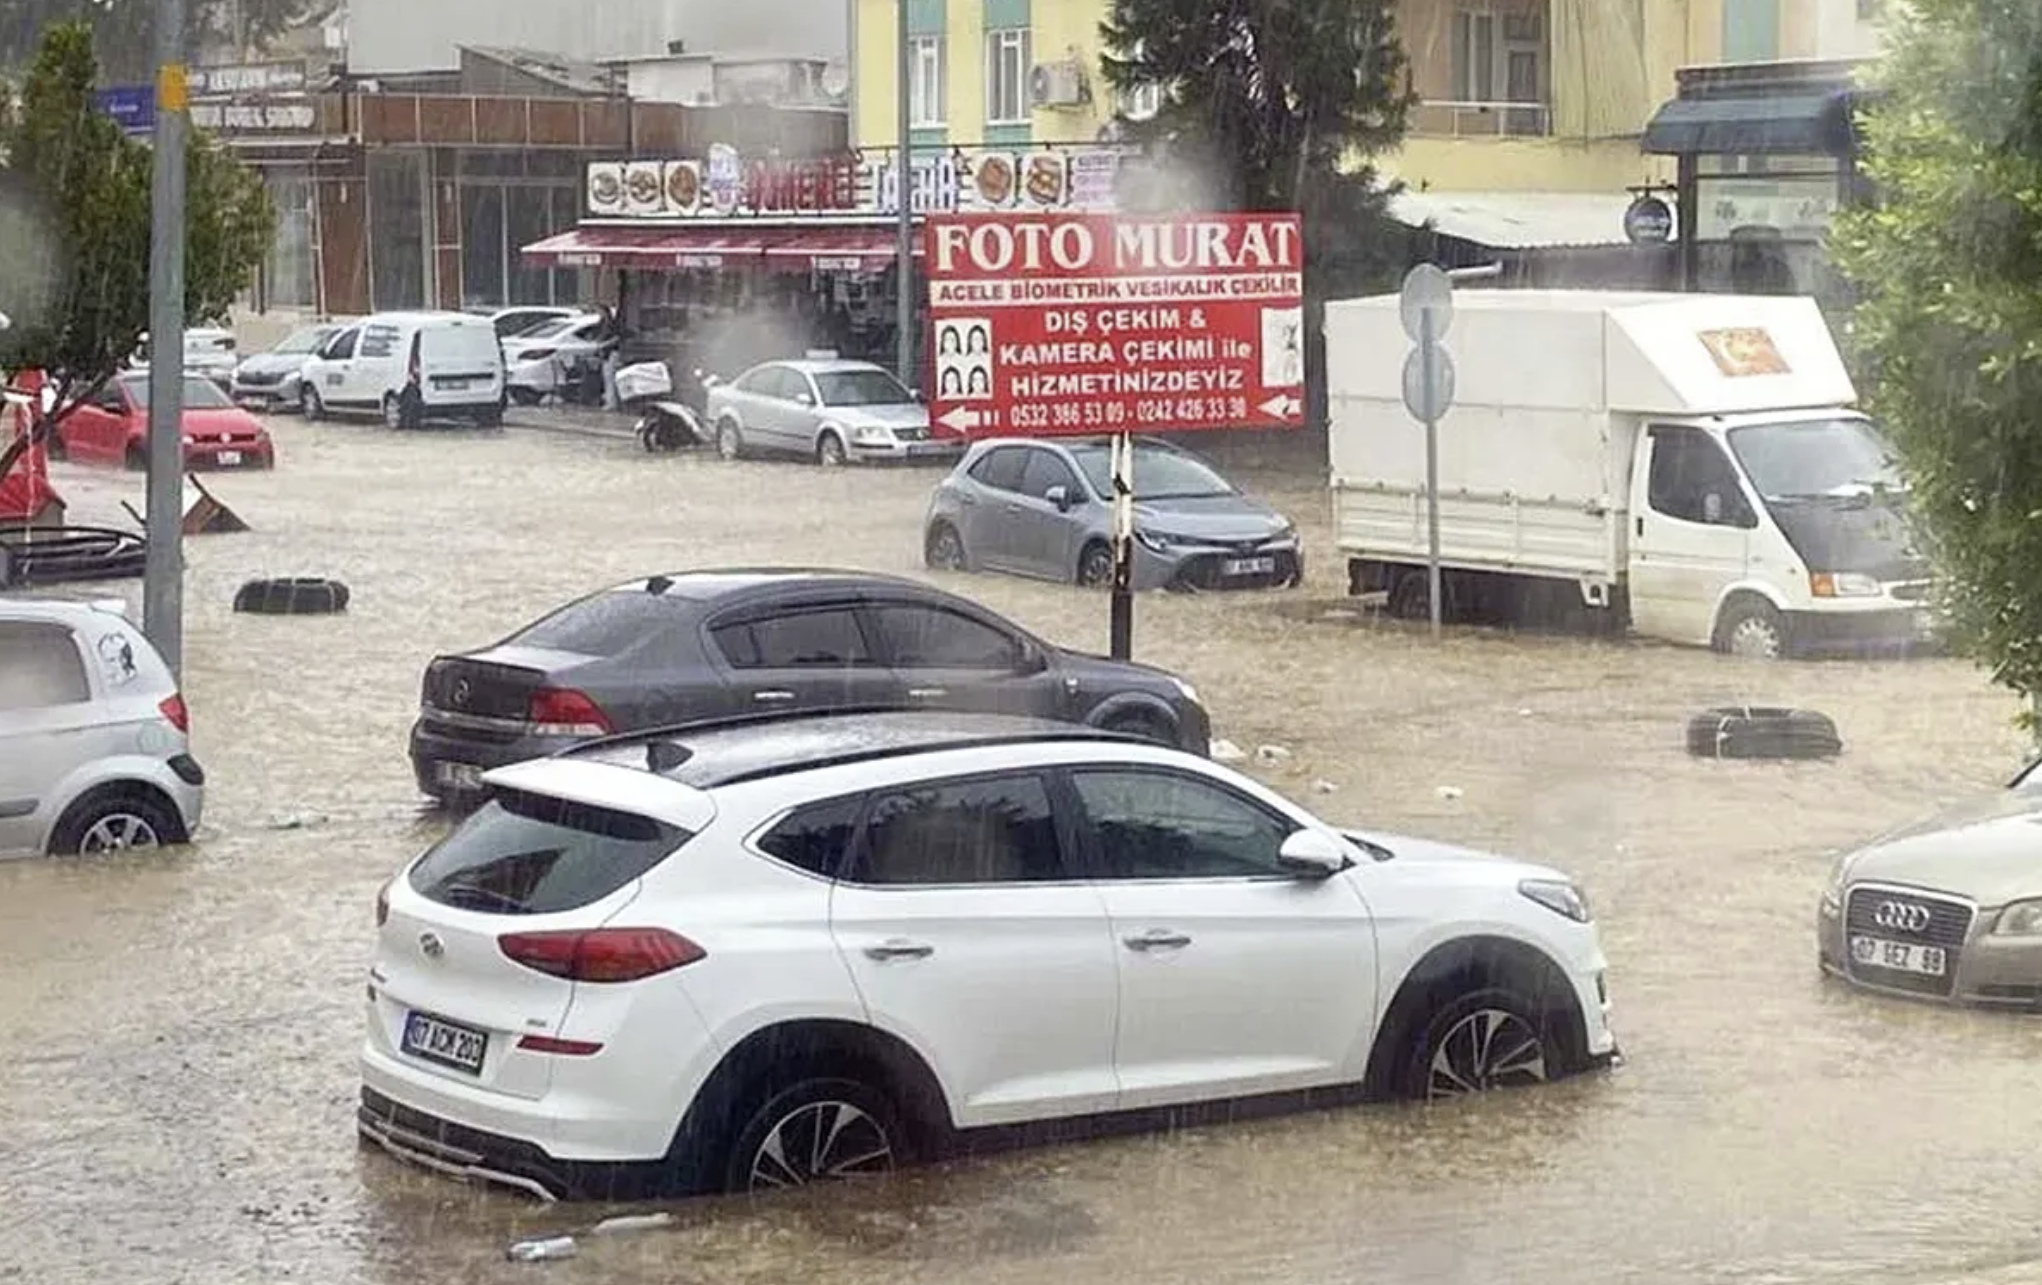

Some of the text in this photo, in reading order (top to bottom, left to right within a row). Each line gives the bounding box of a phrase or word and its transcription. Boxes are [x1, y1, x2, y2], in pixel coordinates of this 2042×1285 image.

[935, 220, 1297, 271] FOTO MURAT
[939, 283, 1002, 302] ACELE
[1011, 279, 1120, 300] BİOMETRİK
[1127, 277, 1226, 298] VESİKALIK
[1044, 304, 1207, 335] DIŞ ÇEKİM &
[1000, 337, 1254, 367] KAMERA ÇEKİMİ ile
[1010, 368, 1243, 398] HİZMETİNİZDEYİZ
[1010, 404, 1049, 427] 0532
[1137, 400, 1174, 422] 0242
